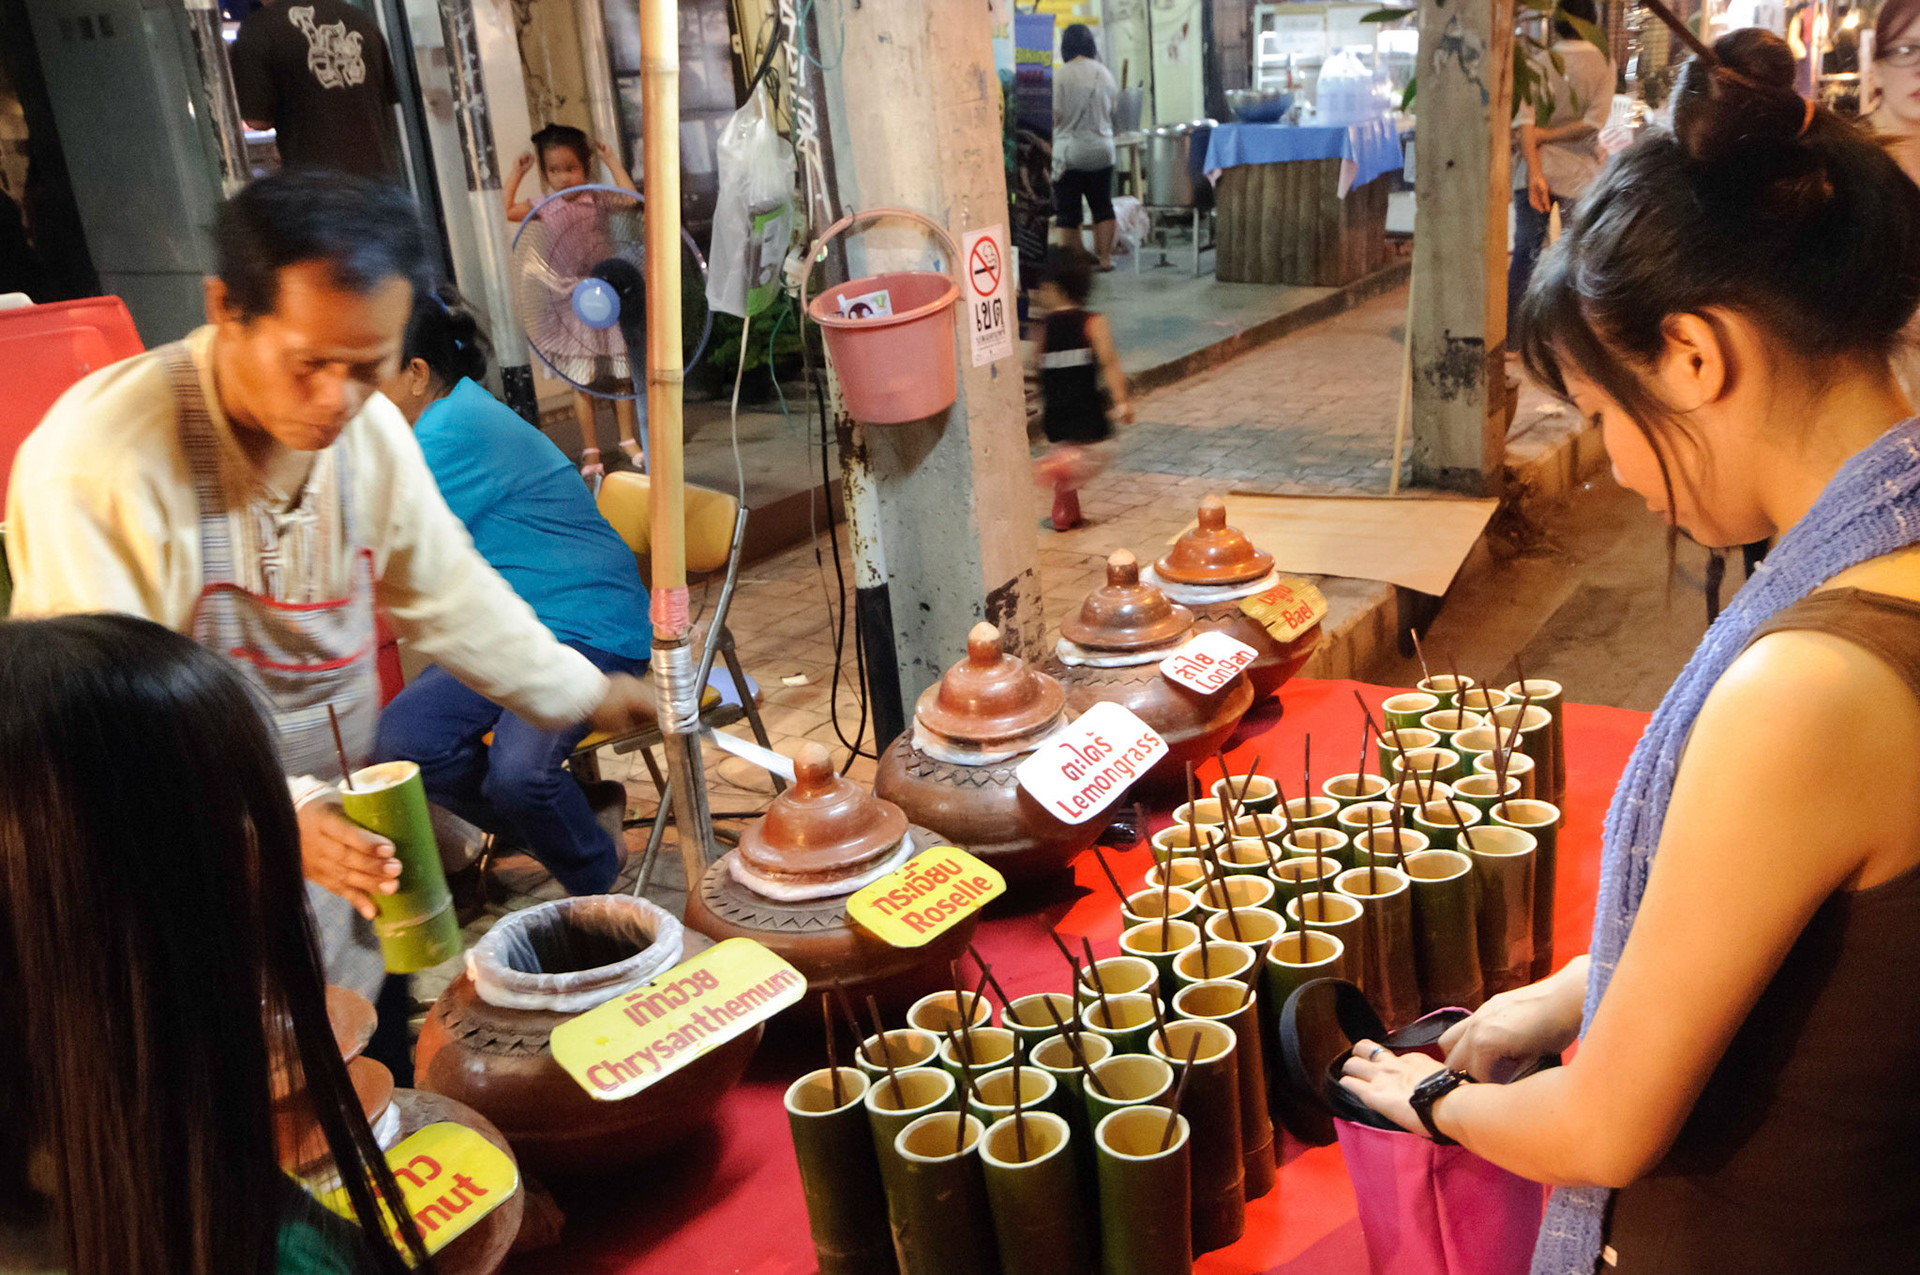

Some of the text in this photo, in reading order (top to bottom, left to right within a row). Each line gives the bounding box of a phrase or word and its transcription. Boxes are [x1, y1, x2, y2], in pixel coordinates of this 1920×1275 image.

[975, 298, 1004, 332] เขต
[1281, 599, 1314, 630] Bael
[1195, 650, 1255, 691] Longan
[1056, 732, 1160, 819] Lemongrass
[1058, 731, 1113, 782] ตะไคร้
[871, 858, 963, 916] กระเจี๊ยบ
[900, 876, 993, 934] Roselle
[586, 969, 800, 1092] Chrysanthemum
